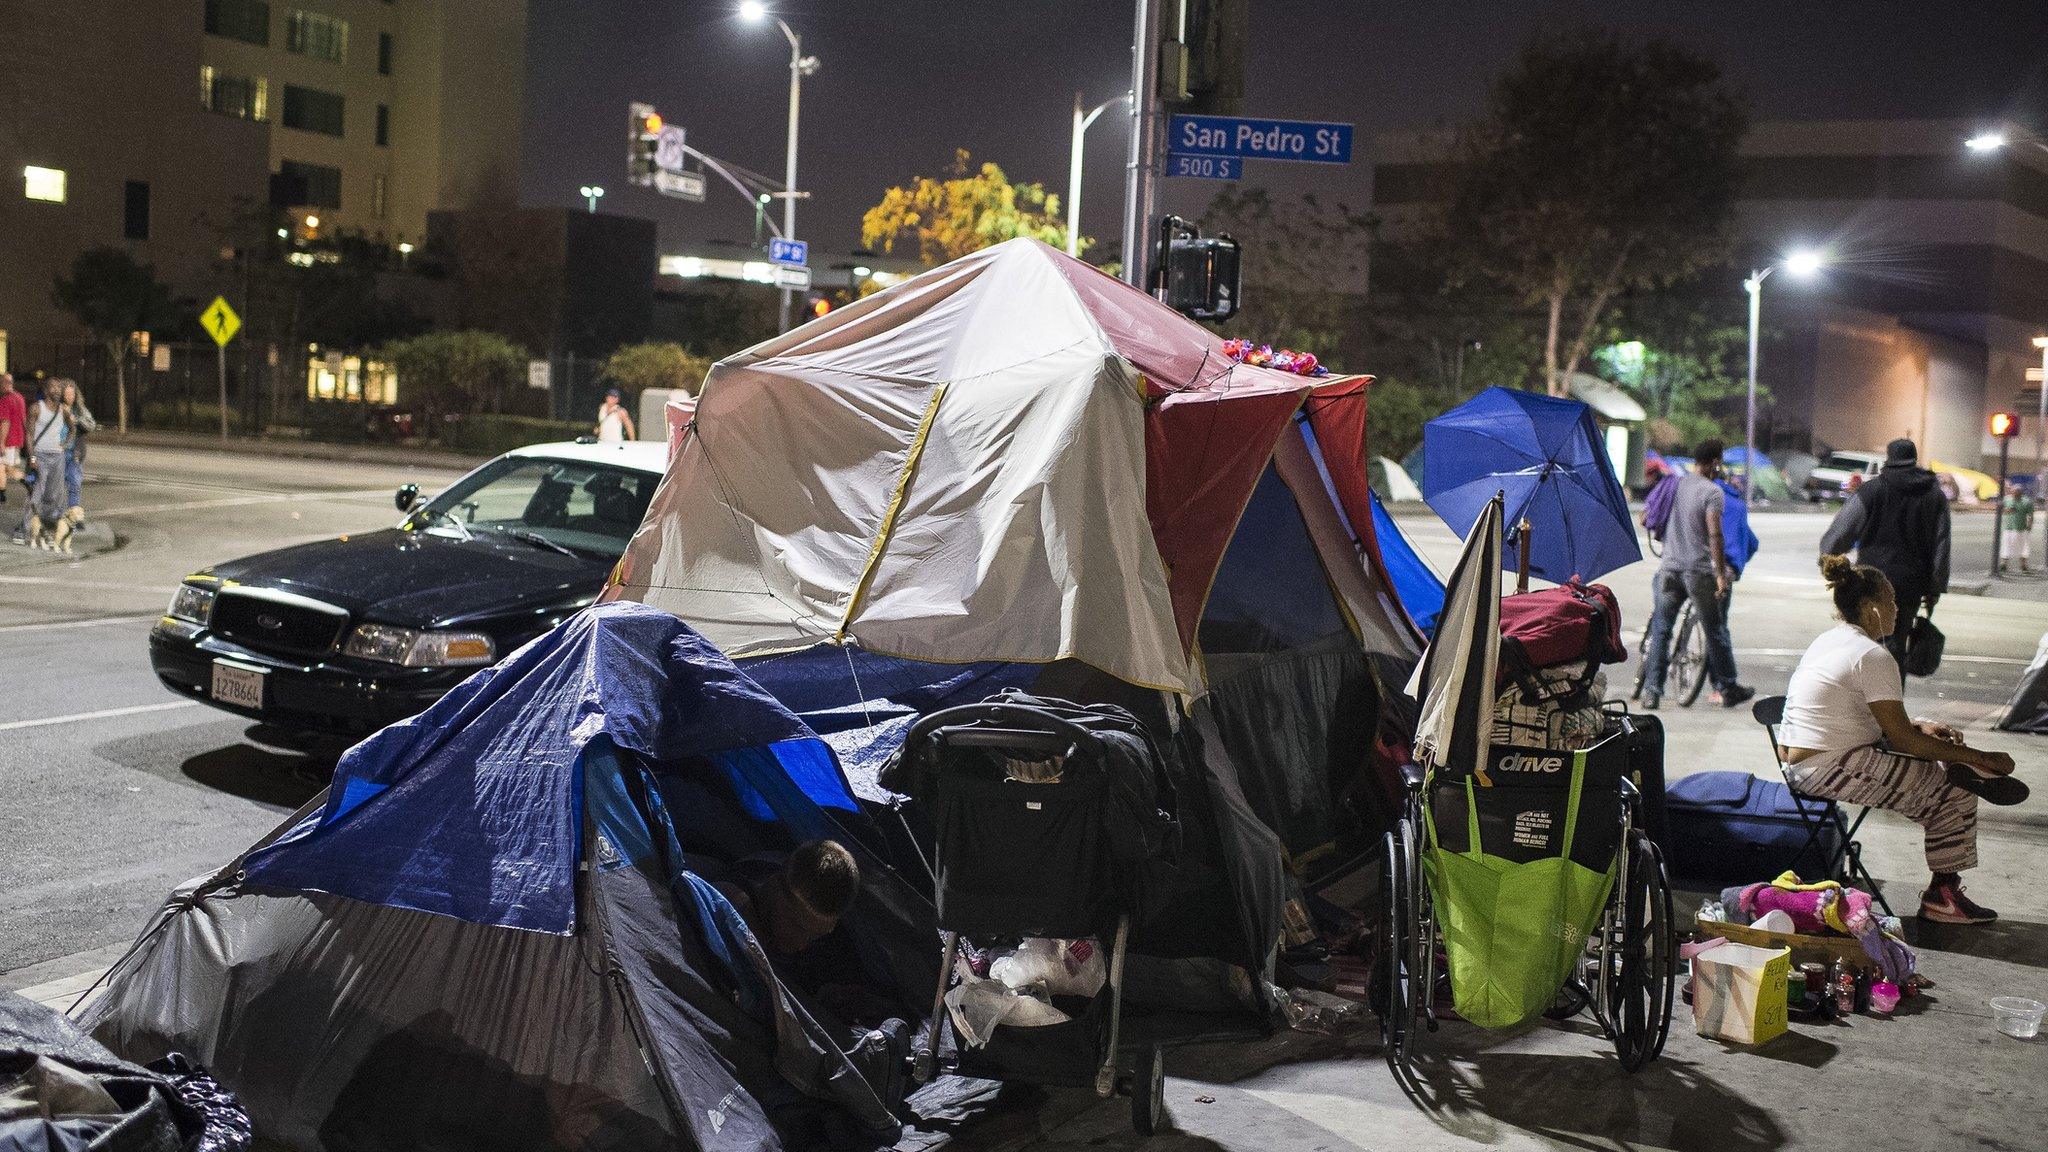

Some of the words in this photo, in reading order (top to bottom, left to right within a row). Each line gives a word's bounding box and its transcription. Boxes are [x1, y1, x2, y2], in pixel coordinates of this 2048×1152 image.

[1182, 121, 1227, 148] San
[1236, 124, 1305, 153] Pedro
[1315, 128, 1341, 156] St
[1180, 157, 1213, 177] 500
[1219, 160, 1230, 178] S
[215, 677, 259, 703] 1278664
[1498, 752, 1563, 773] drive
